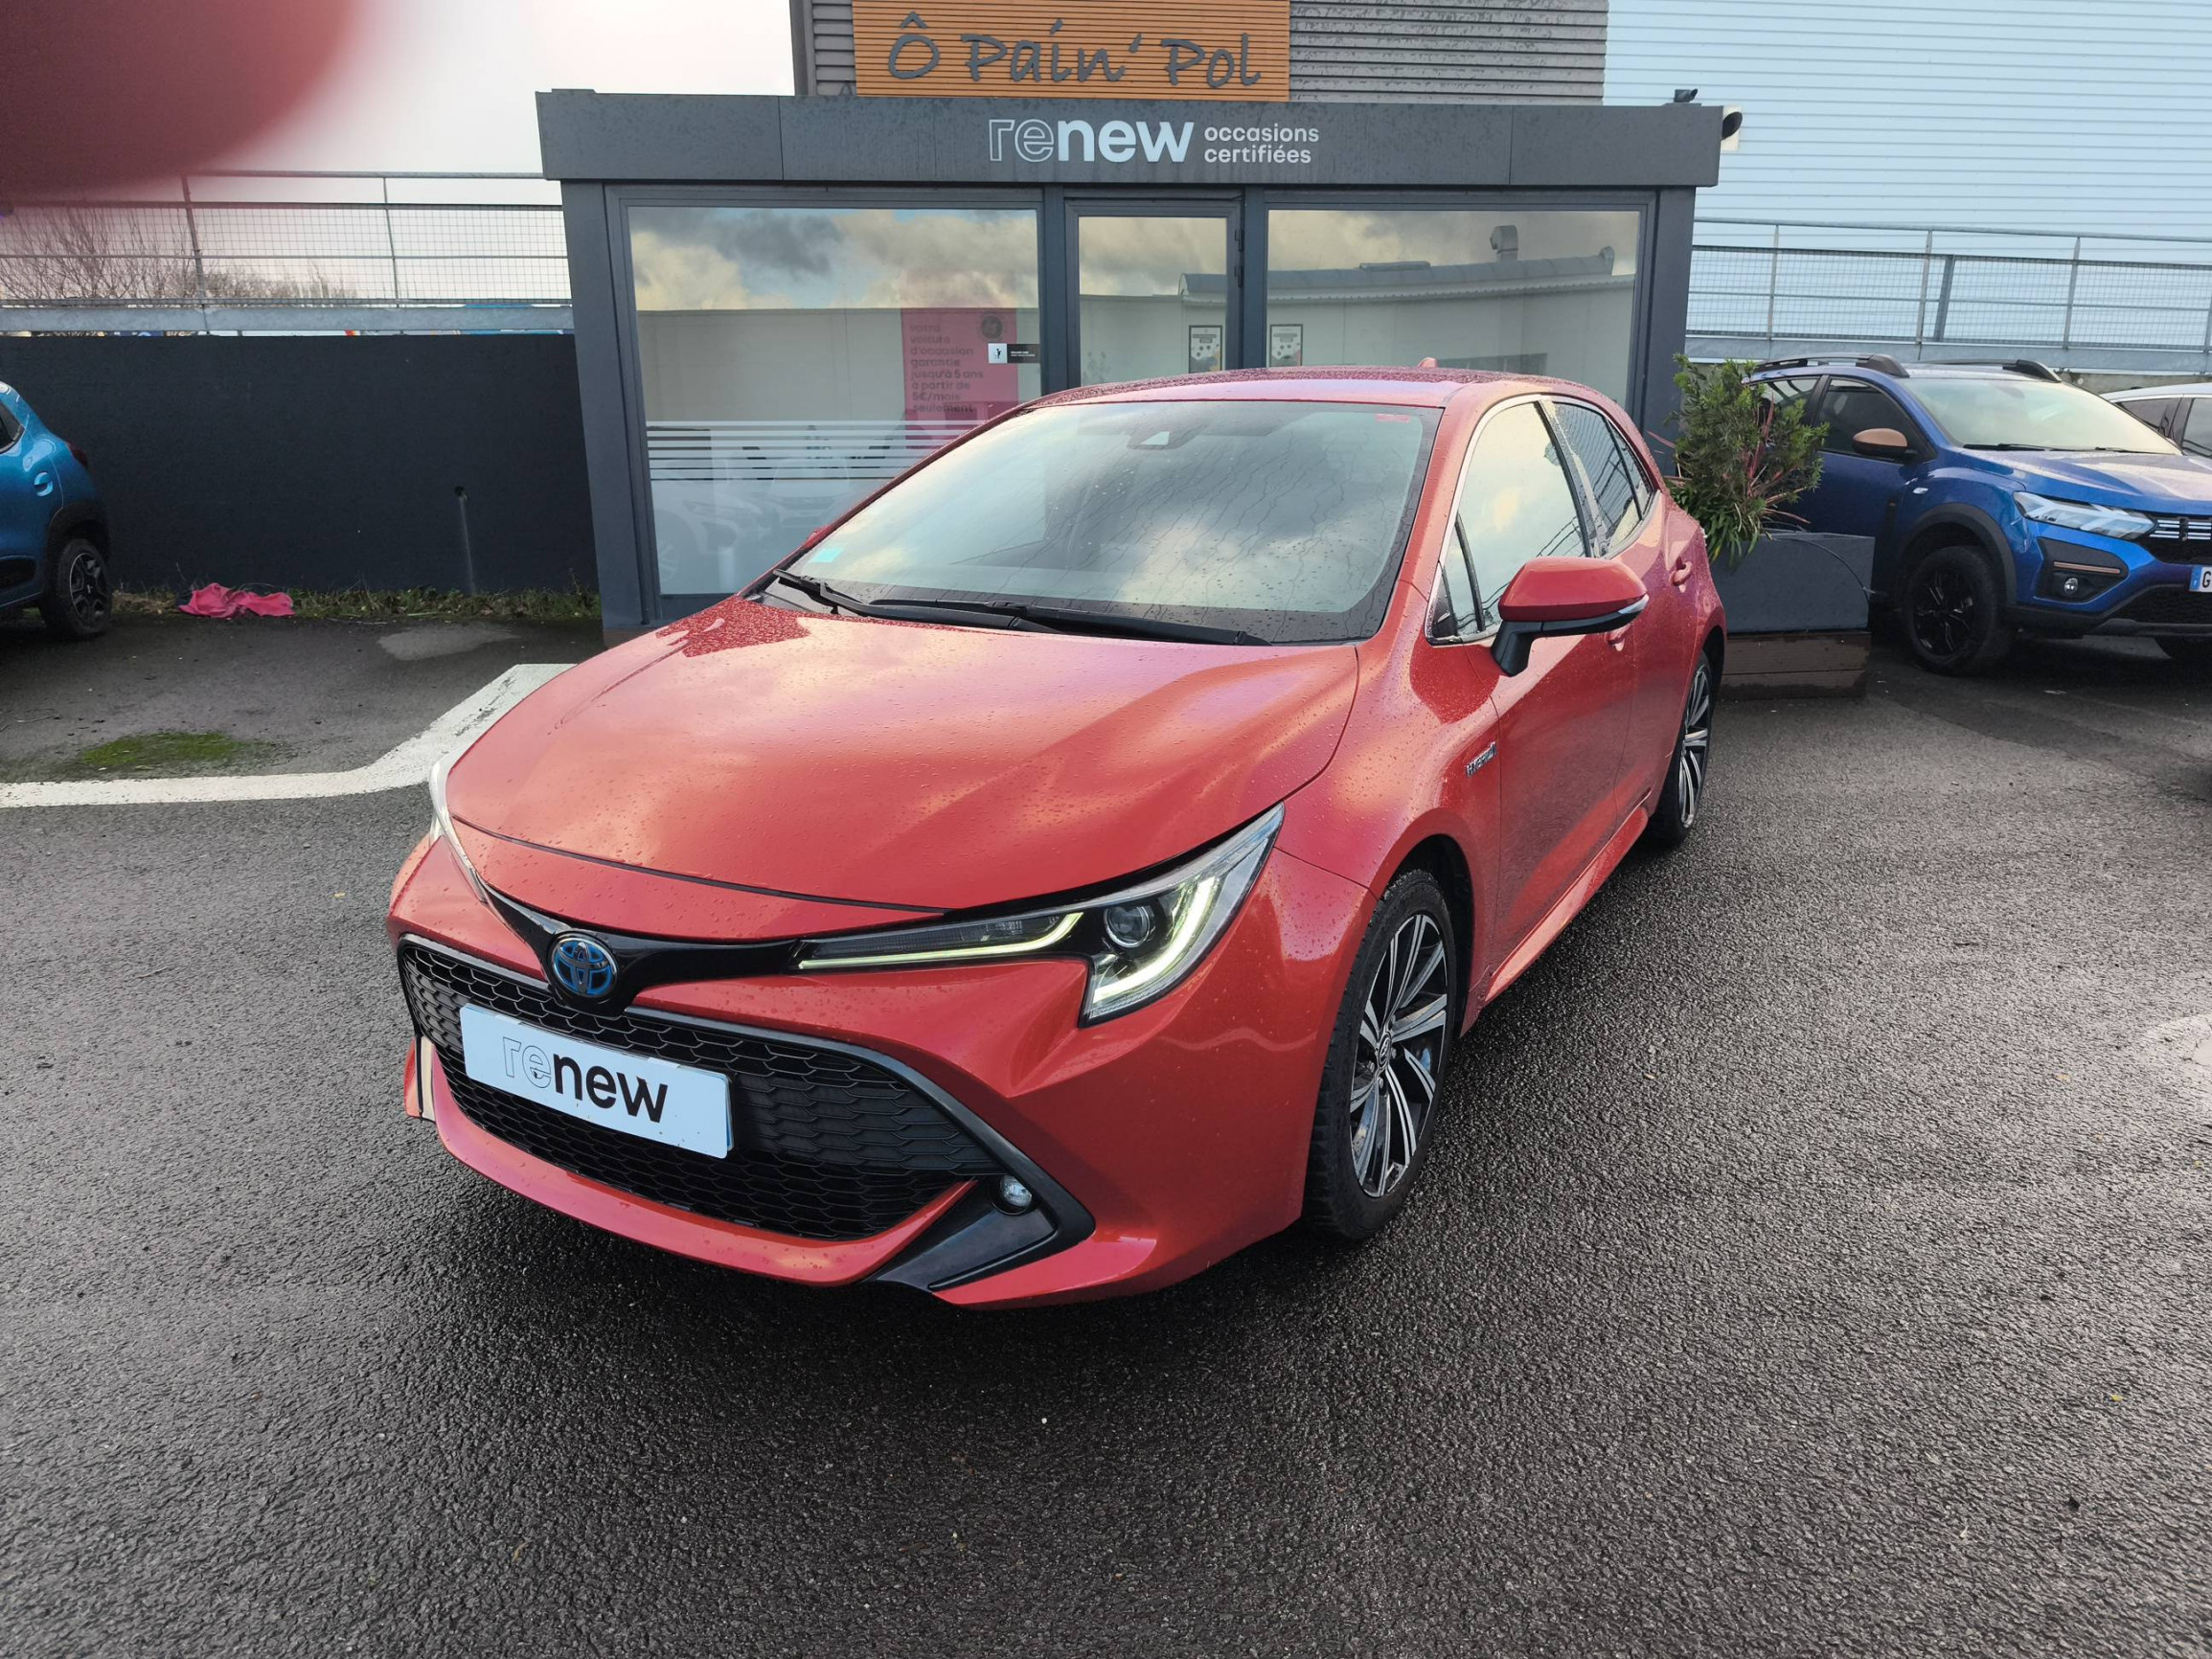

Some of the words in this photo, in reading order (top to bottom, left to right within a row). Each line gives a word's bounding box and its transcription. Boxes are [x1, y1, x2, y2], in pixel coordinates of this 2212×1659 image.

[888, 11, 940, 80] Ô
[1161, 33, 1261, 88] Pol
[989, 119, 1195, 163] renew
[1204, 124, 1319, 144] occasions
[1204, 143, 1311, 164] certifiées
[910, 346, 974, 356] d'occasion
[910, 358, 961, 369] garantie
[921, 381, 954, 392] partir
[503, 1036, 668, 1124] renew
